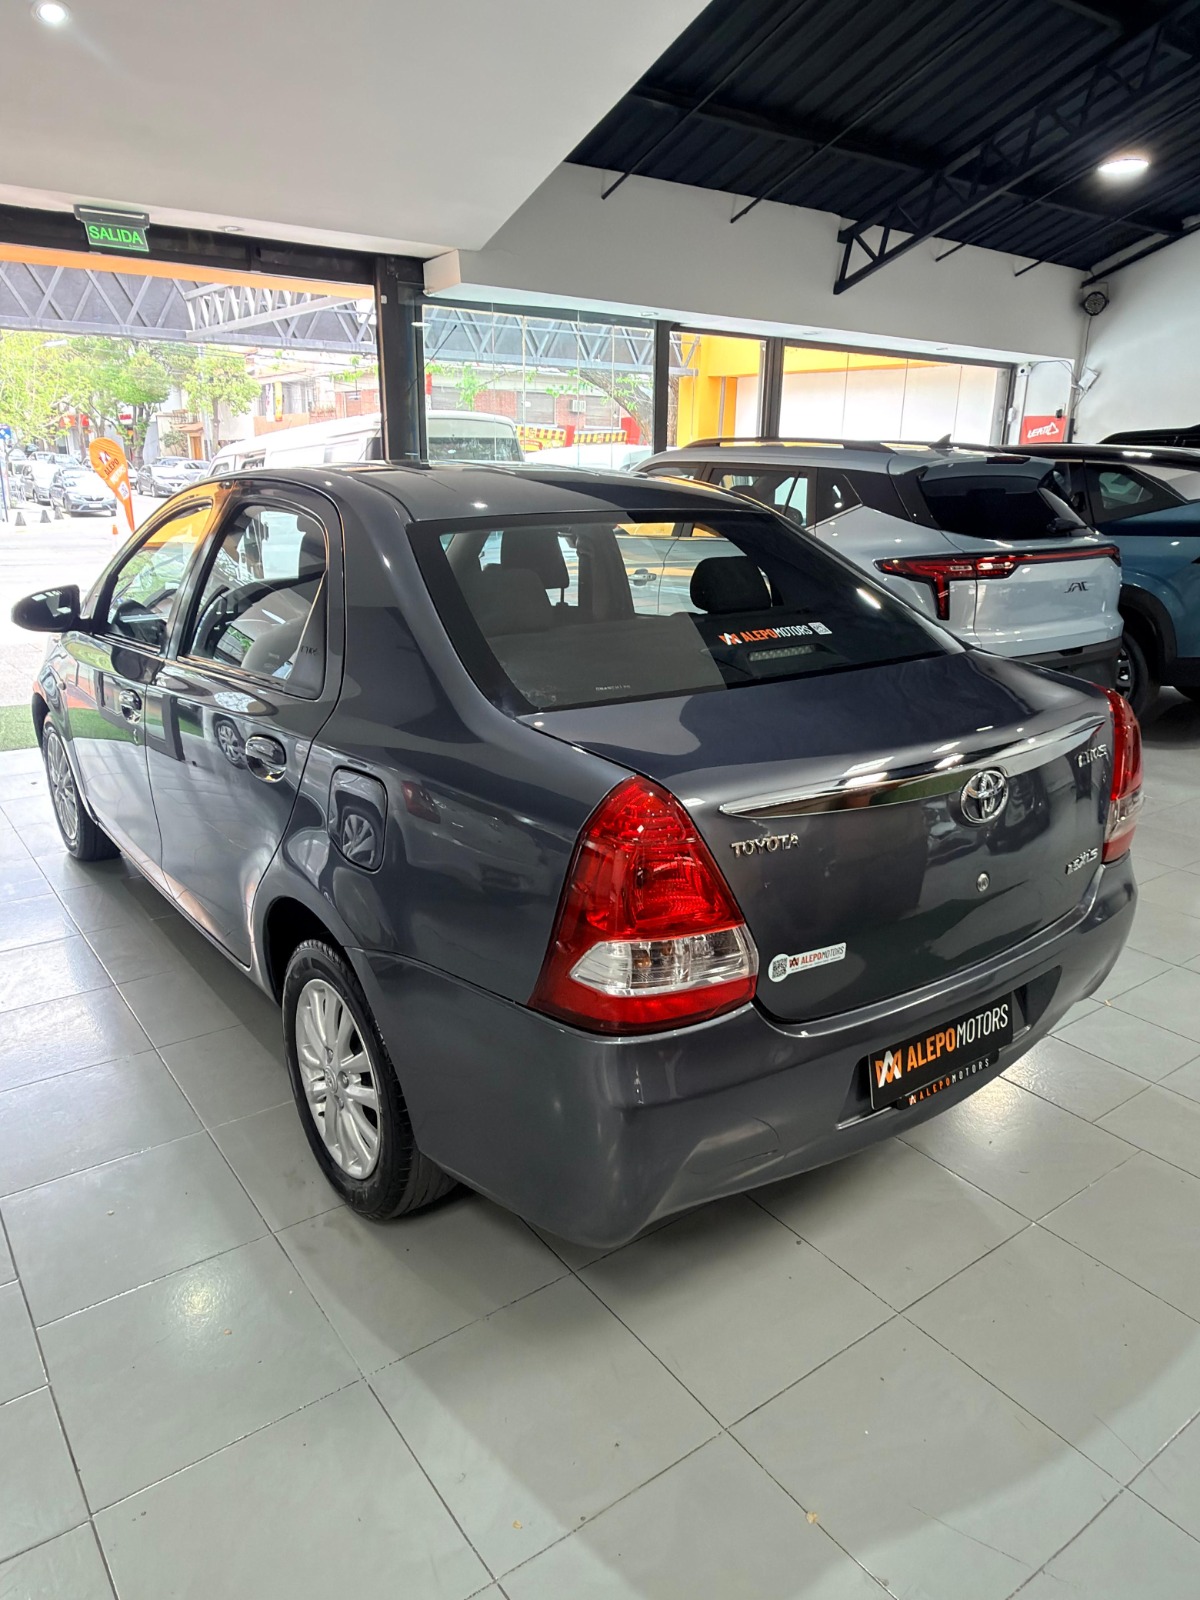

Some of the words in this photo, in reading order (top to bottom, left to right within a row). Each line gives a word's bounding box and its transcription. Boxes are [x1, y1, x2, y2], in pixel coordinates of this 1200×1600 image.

[88, 225, 144, 245] SALIDA
[740, 625, 813, 642] ALEPOMOTORS
[731, 833, 799, 858] TOYOTA
[801, 946, 845, 965] ALEPOMOTORS
[906, 1003, 1009, 1073] ALEPOMOTORS
